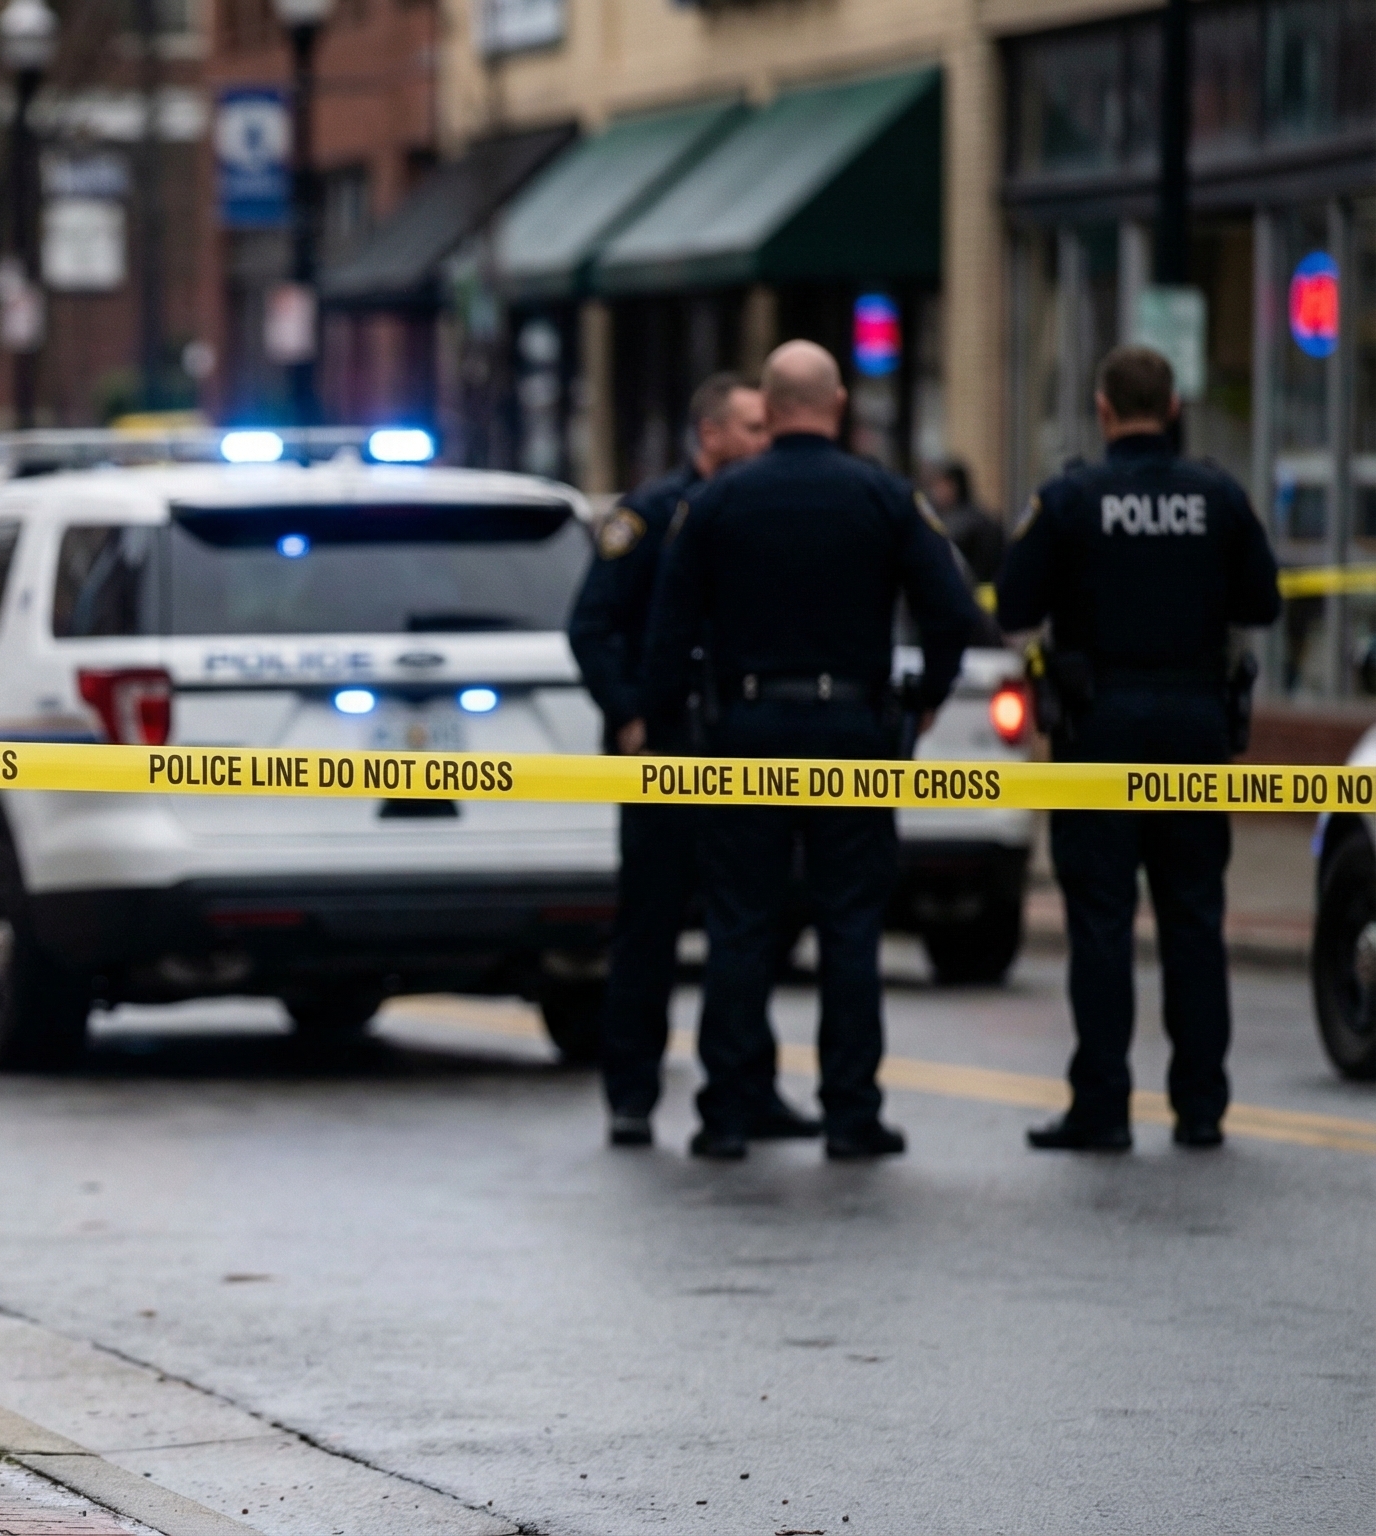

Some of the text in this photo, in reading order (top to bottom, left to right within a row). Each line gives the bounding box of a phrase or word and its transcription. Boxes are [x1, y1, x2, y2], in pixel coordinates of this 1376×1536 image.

[1101, 494, 1206, 536] POLICE
[204, 648, 374, 679] POLICE
[150, 754, 512, 791] POLICE LINE DO NOT CROSS
[643, 764, 1000, 799] POLICE LINE DO NOT CROSS
[1128, 772, 1217, 802] POLICE
[1228, 773, 1283, 803] LINE
[1293, 774, 1327, 804] DO
